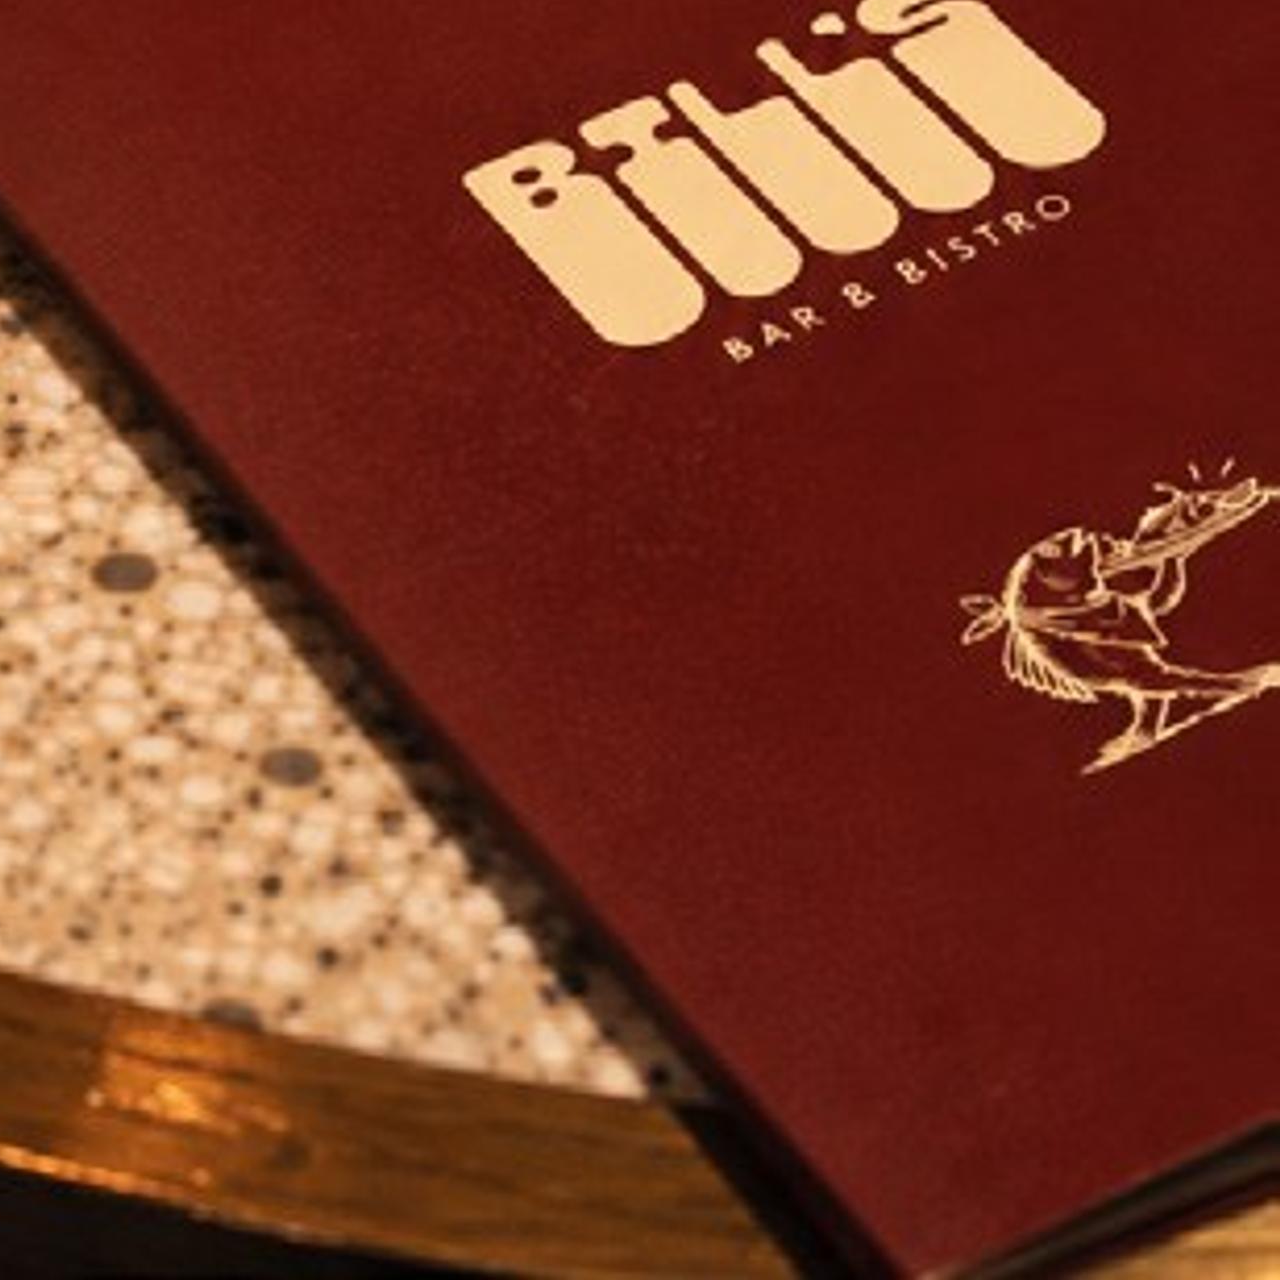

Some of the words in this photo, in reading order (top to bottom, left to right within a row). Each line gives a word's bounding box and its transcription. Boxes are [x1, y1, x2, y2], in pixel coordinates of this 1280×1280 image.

[723, 306, 822, 363] BAR
[841, 281, 876, 310] &
[894, 195, 1071, 284] BISTRO
